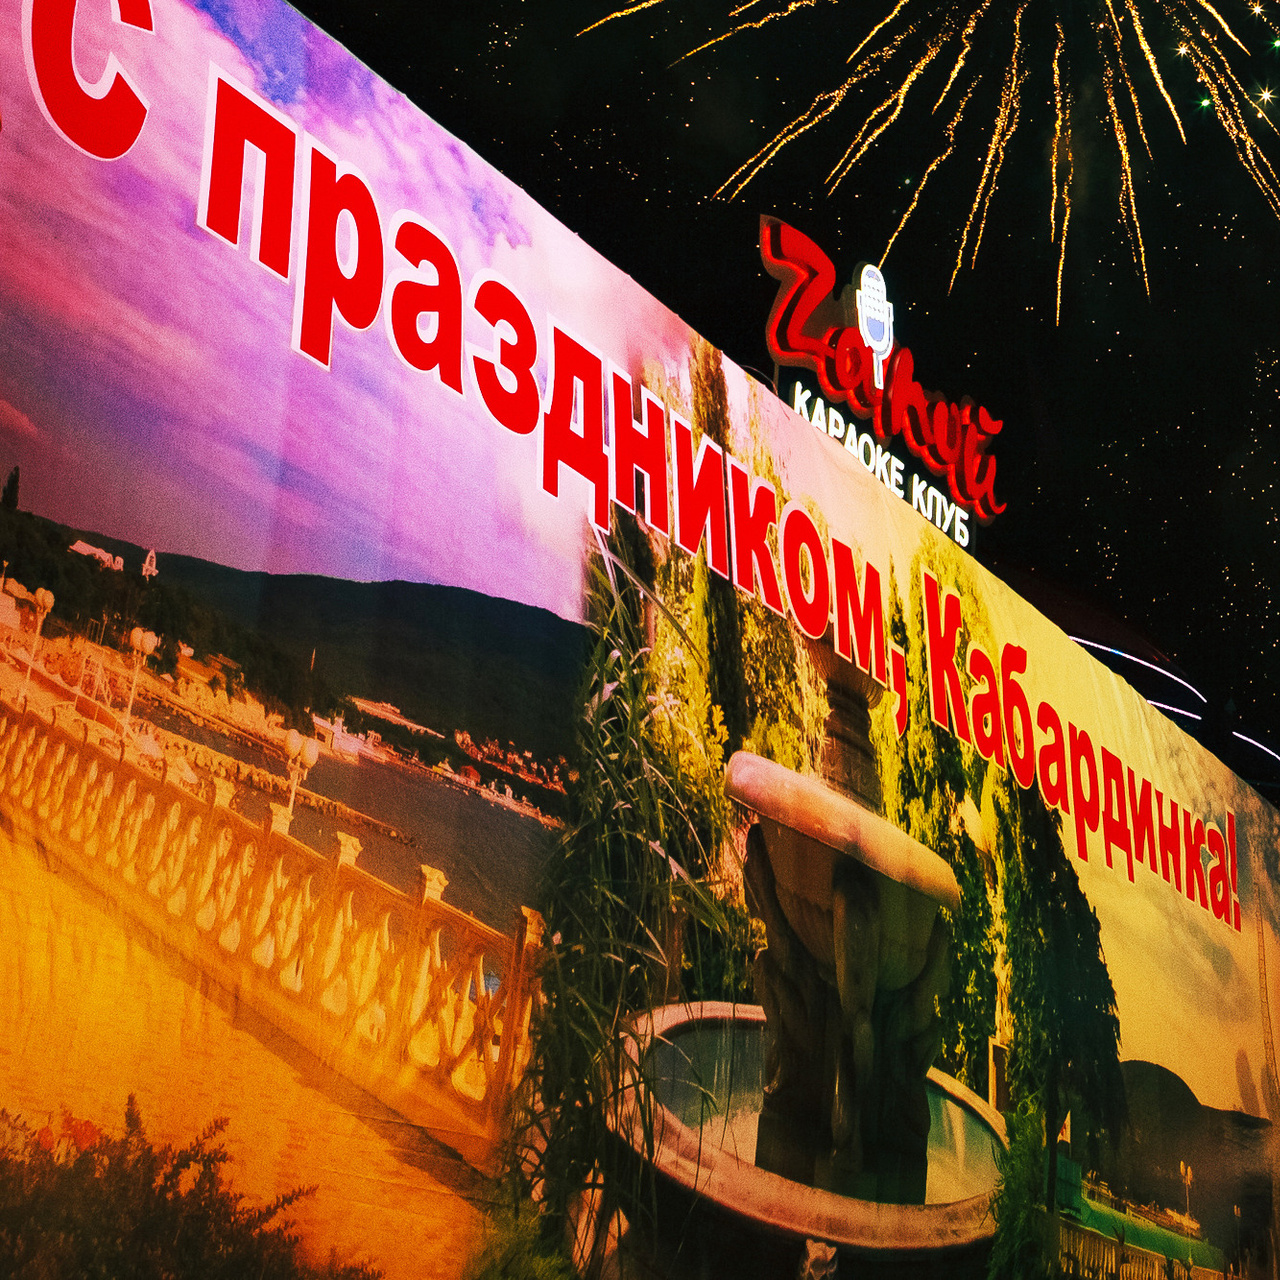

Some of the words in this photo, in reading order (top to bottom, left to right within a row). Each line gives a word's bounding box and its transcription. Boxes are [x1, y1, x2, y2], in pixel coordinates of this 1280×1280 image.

[203, 72, 908, 741] праздником,
[924, 570, 1242, 933] Кабардинка!
[793, 381, 905, 499] КАРАОКЕ
[912, 473, 970, 548] КЛУБ
